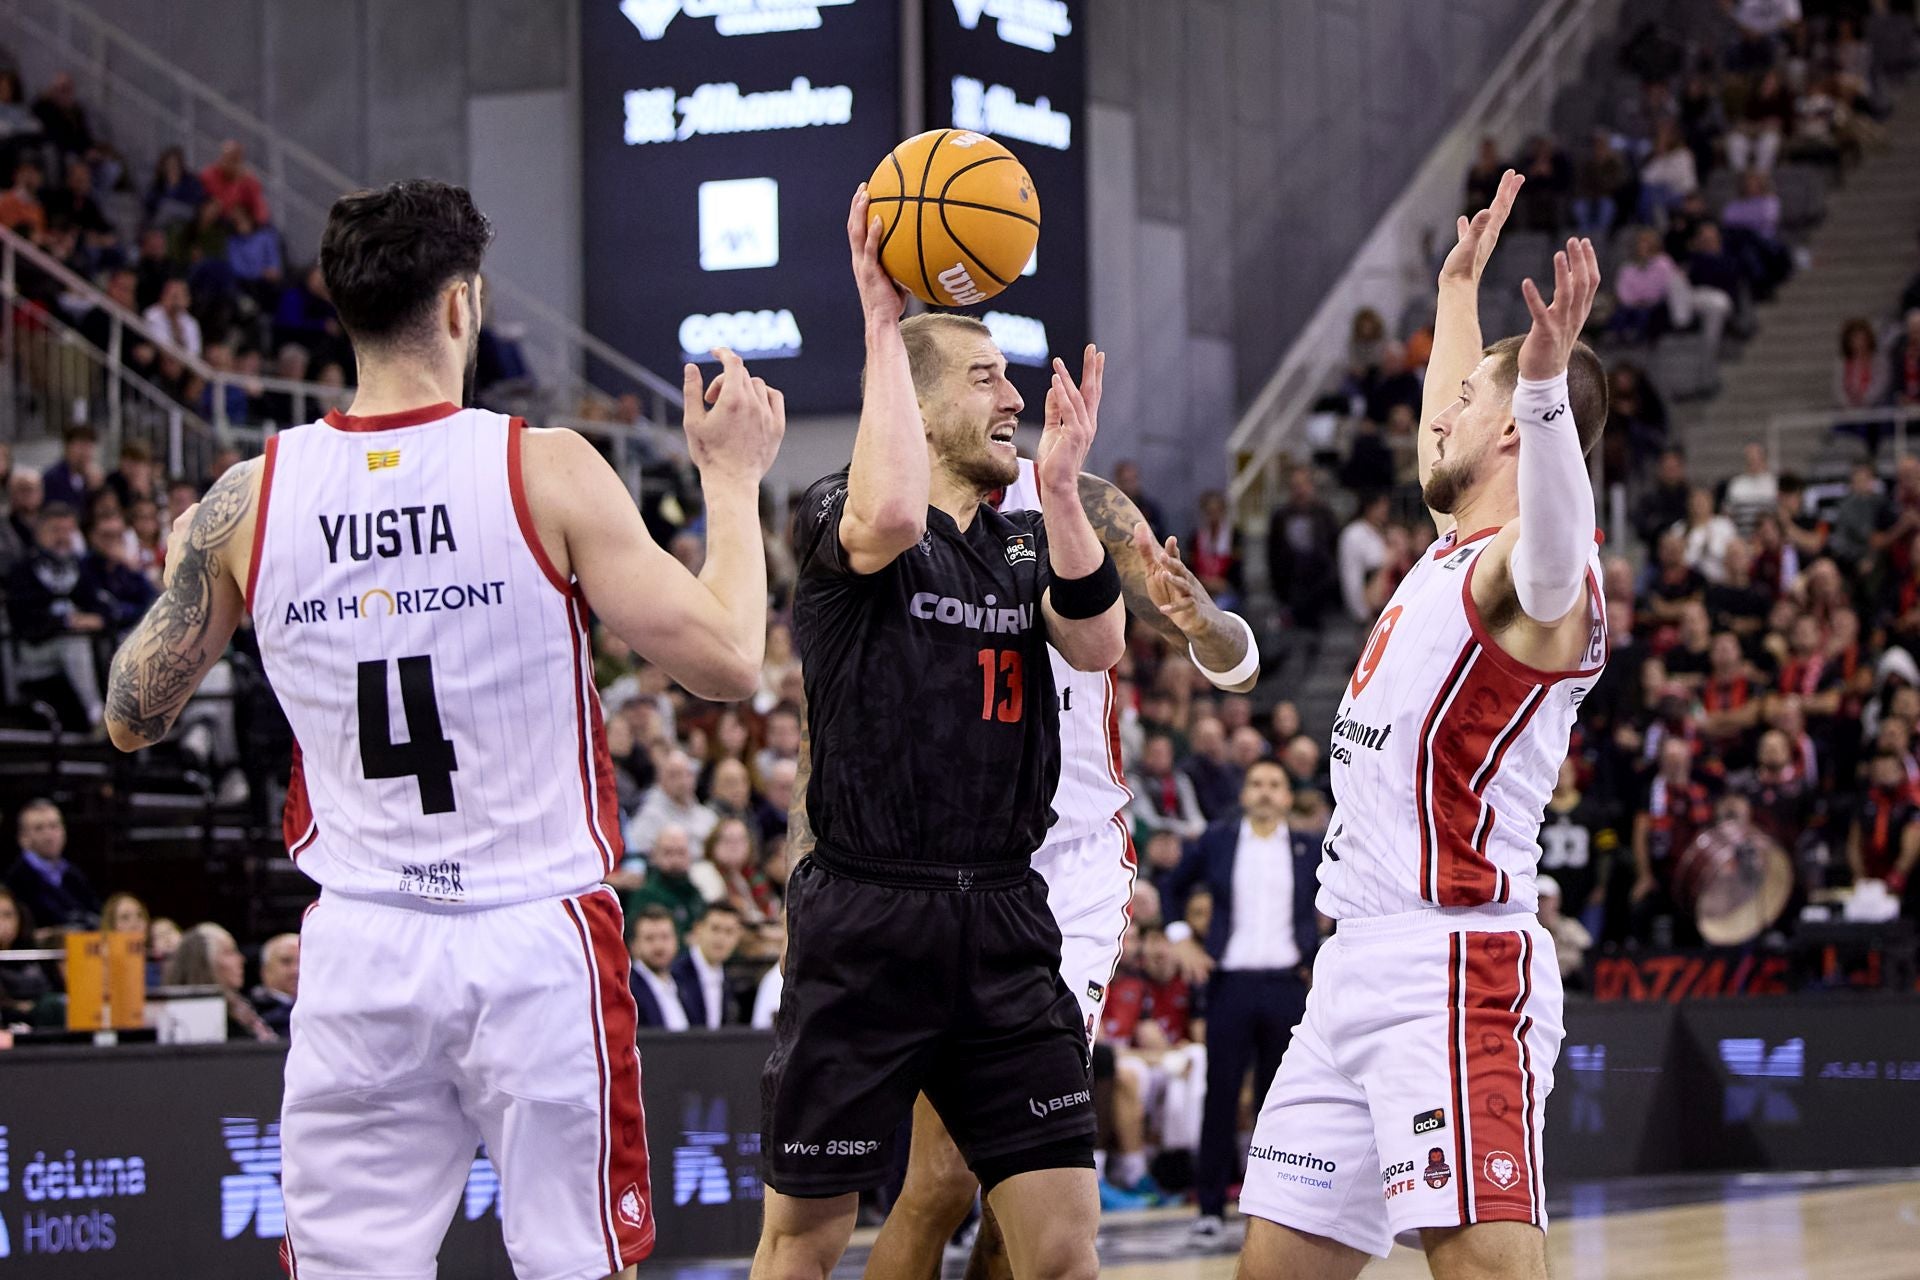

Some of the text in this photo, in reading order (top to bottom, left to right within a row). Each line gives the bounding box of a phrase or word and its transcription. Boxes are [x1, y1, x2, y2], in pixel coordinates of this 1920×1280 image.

[938, 262, 986, 305] Wil
[319, 504, 457, 563] YUSTA
[1010, 549, 1037, 560] ende
[285, 581, 505, 625] AIR HORIZONT
[977, 648, 1023, 723] 13
[357, 654, 458, 815] 4
[1333, 707, 1392, 751] demont
[418, 882, 465, 896] VERD
[1415, 1118, 1439, 1132] acb
[784, 1141, 820, 1156] vive
[1276, 1171, 1333, 1190] new travel
[1384, 1179, 1415, 1200] ORTE
